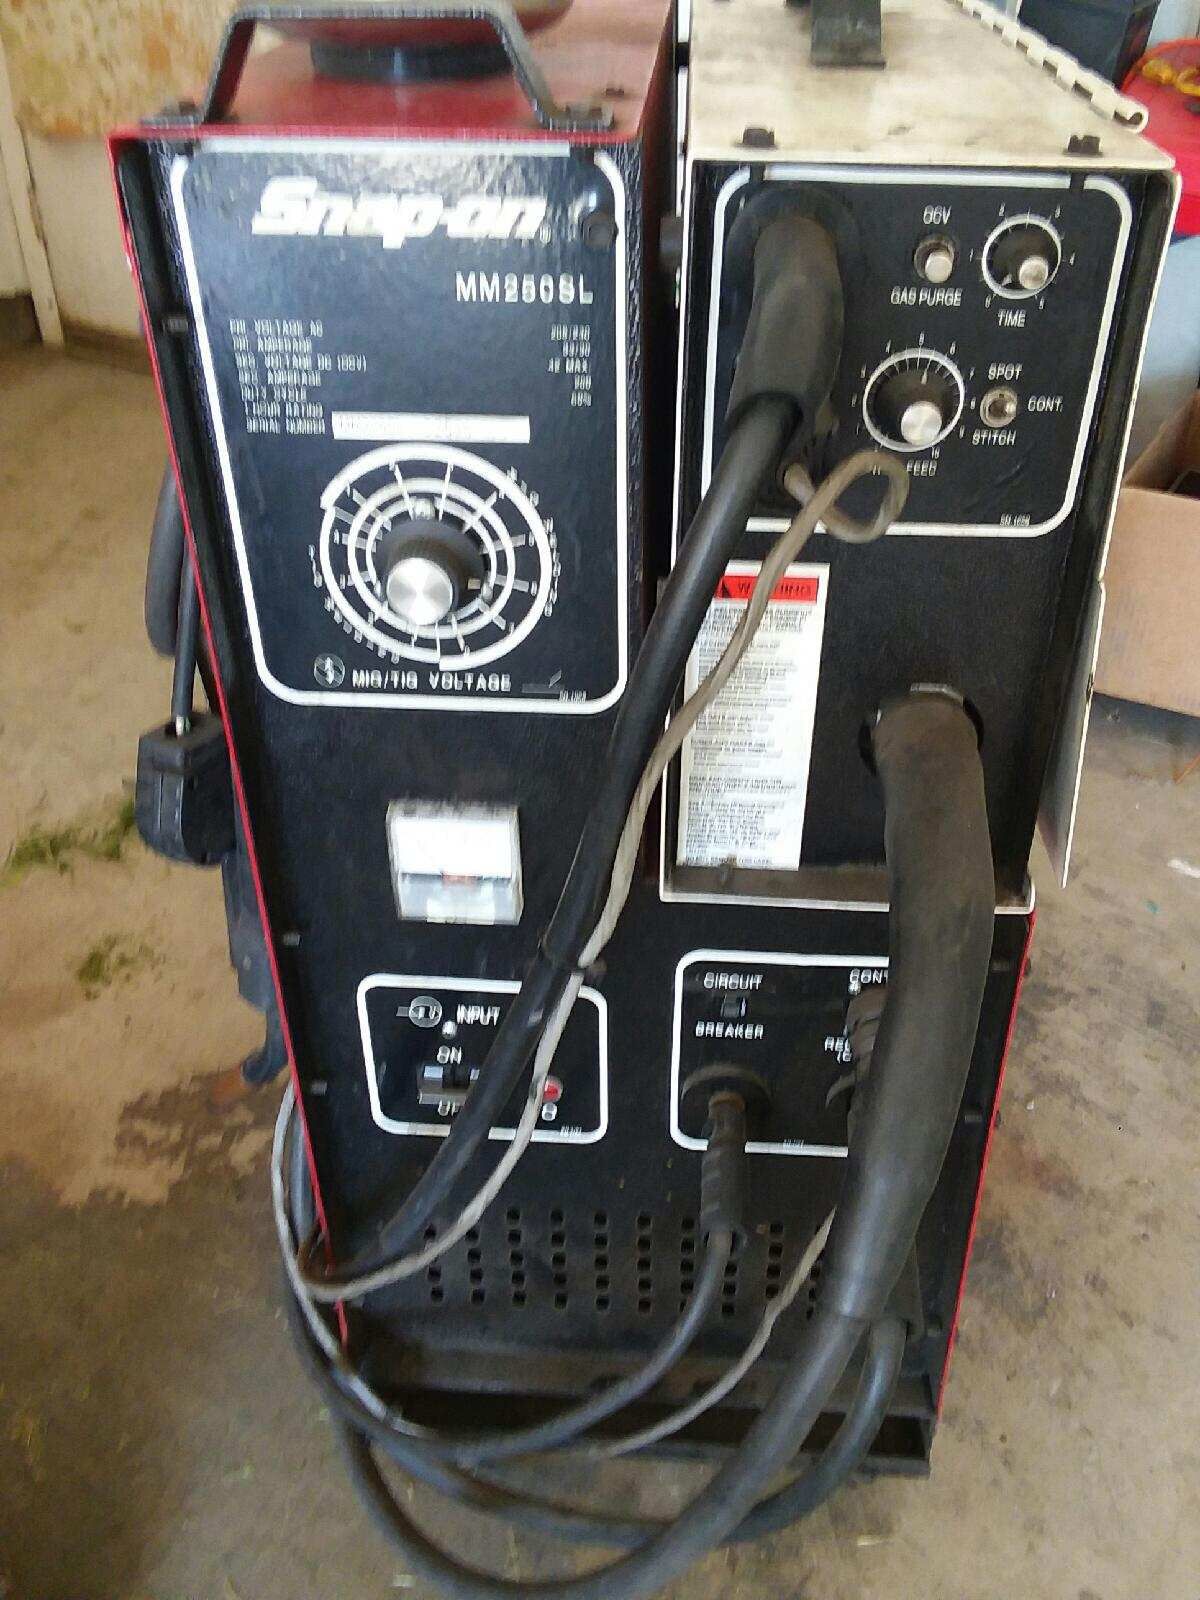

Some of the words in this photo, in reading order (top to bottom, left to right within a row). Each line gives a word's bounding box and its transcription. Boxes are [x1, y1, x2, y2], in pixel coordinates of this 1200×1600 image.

[252, 176, 548, 248] Snap-on
[455, 270, 594, 304] MM250SL
[890, 285, 917, 306] GAS
[919, 286, 963, 306] PURGE
[997, 308, 1027, 327] TIME
[988, 362, 1023, 381] SPOT
[972, 428, 1017, 446] STITCH
[352, 669, 418, 690] MIG/TIG
[429, 670, 511, 692] VOLTAGE
[703, 971, 764, 991] CIRCUIT
[456, 1003, 501, 1027] INPUT
[695, 1020, 764, 1040] BREAKER
[436, 1045, 462, 1065] ON
